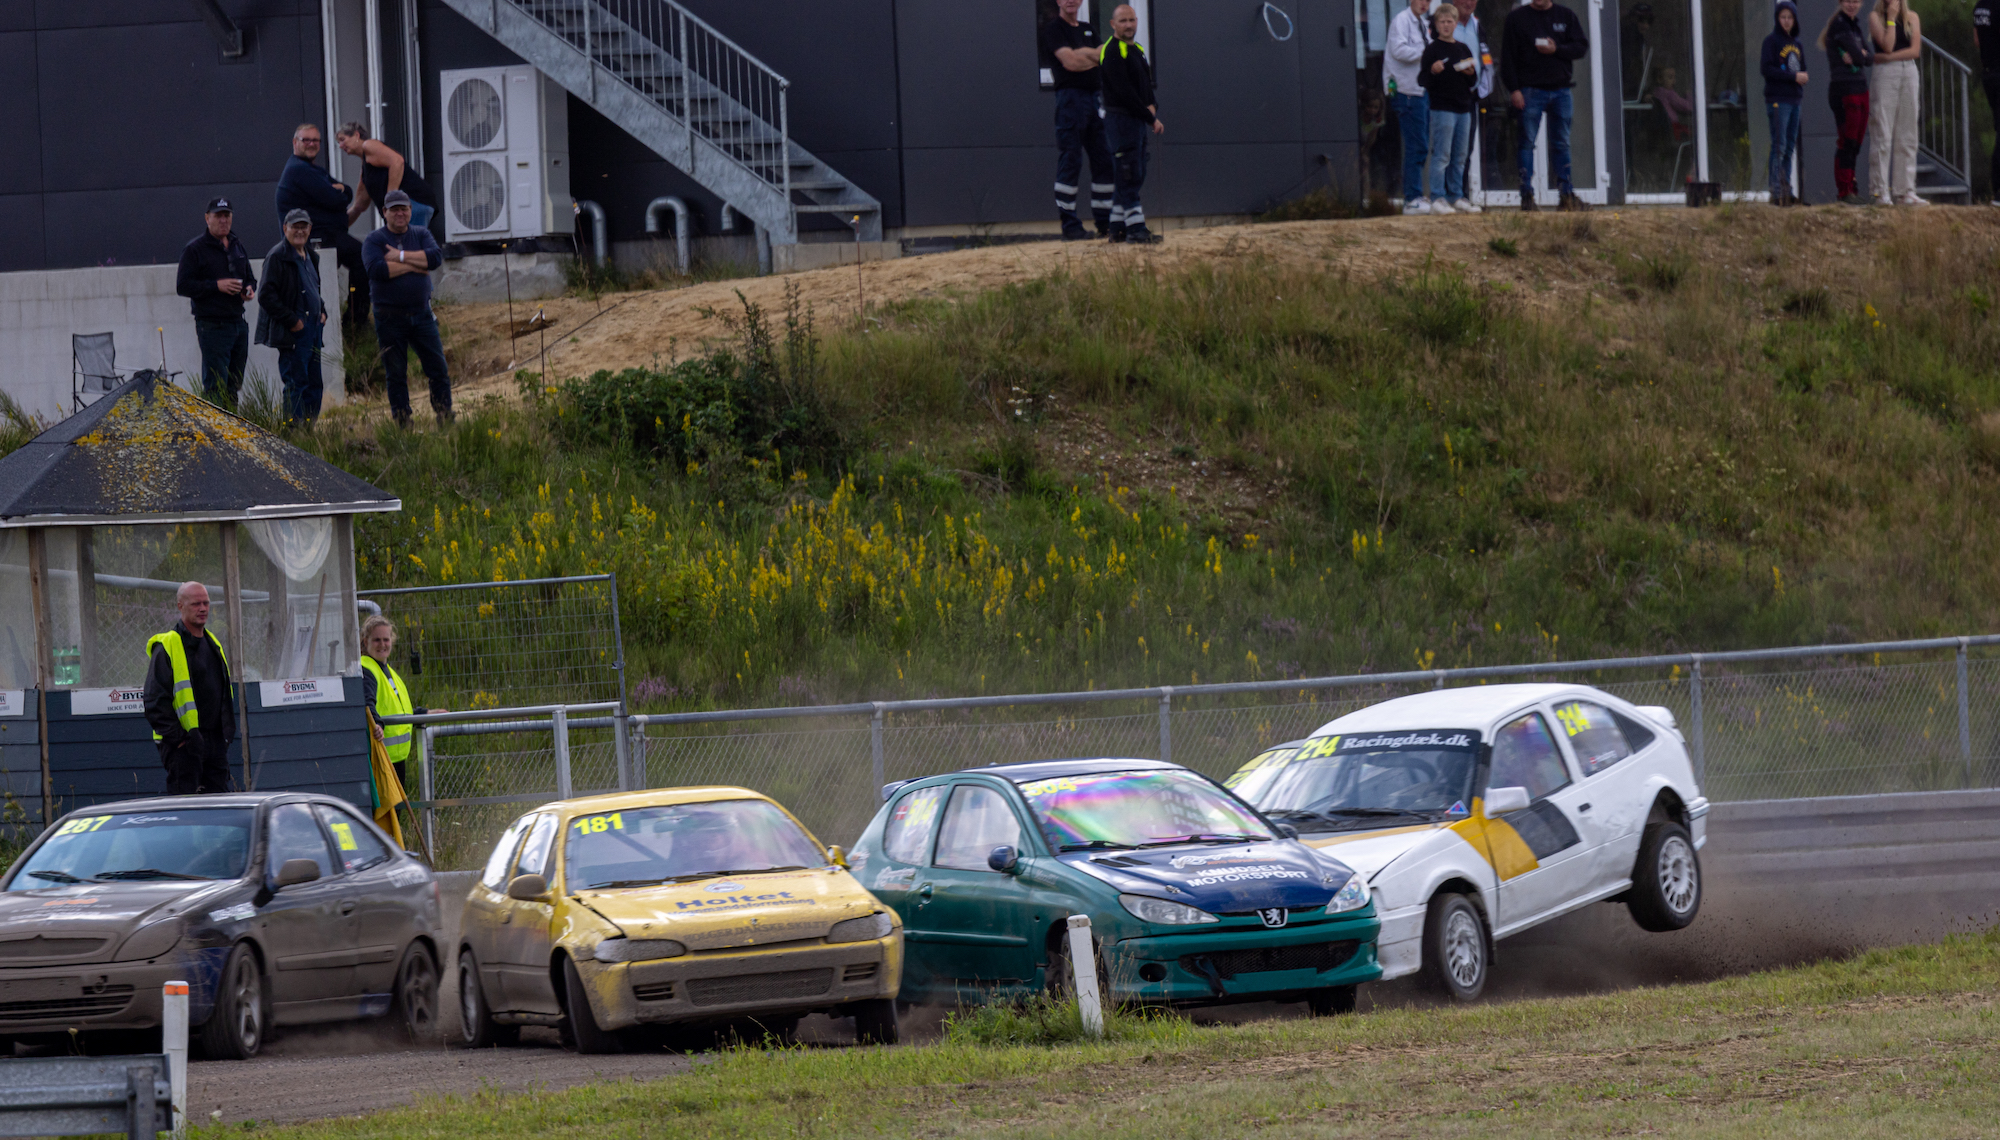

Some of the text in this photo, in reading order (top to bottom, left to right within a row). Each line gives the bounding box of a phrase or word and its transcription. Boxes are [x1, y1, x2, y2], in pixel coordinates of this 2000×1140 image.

[291, 682, 316, 692] BYGMA
[1294, 733, 1472, 761] 214 Racingdæk.dk
[1024, 777, 1078, 797] 504
[54, 815, 114, 837] 287
[573, 812, 624, 836] 181
[1186, 870, 1309, 888] MOTORSPORT
[1196, 864, 1286, 877] KNUDSEN
[675, 891, 795, 910] Holtet
